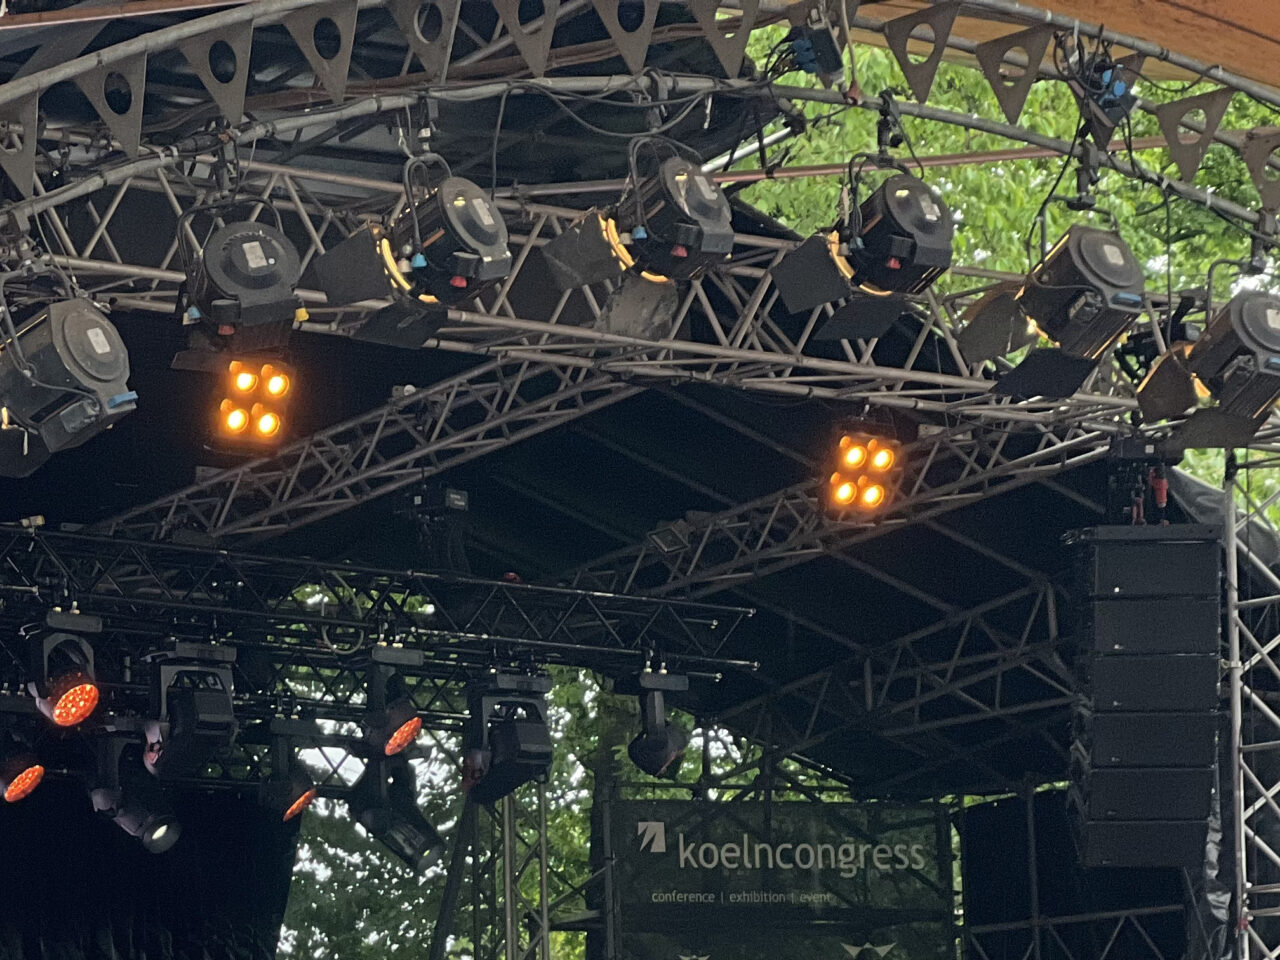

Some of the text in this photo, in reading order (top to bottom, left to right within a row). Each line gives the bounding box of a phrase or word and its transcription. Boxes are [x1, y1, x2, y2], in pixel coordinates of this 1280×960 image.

[678, 832, 927, 878] koelncongress
[651, 889, 716, 903] conference
[729, 890, 786, 903] exhibition
